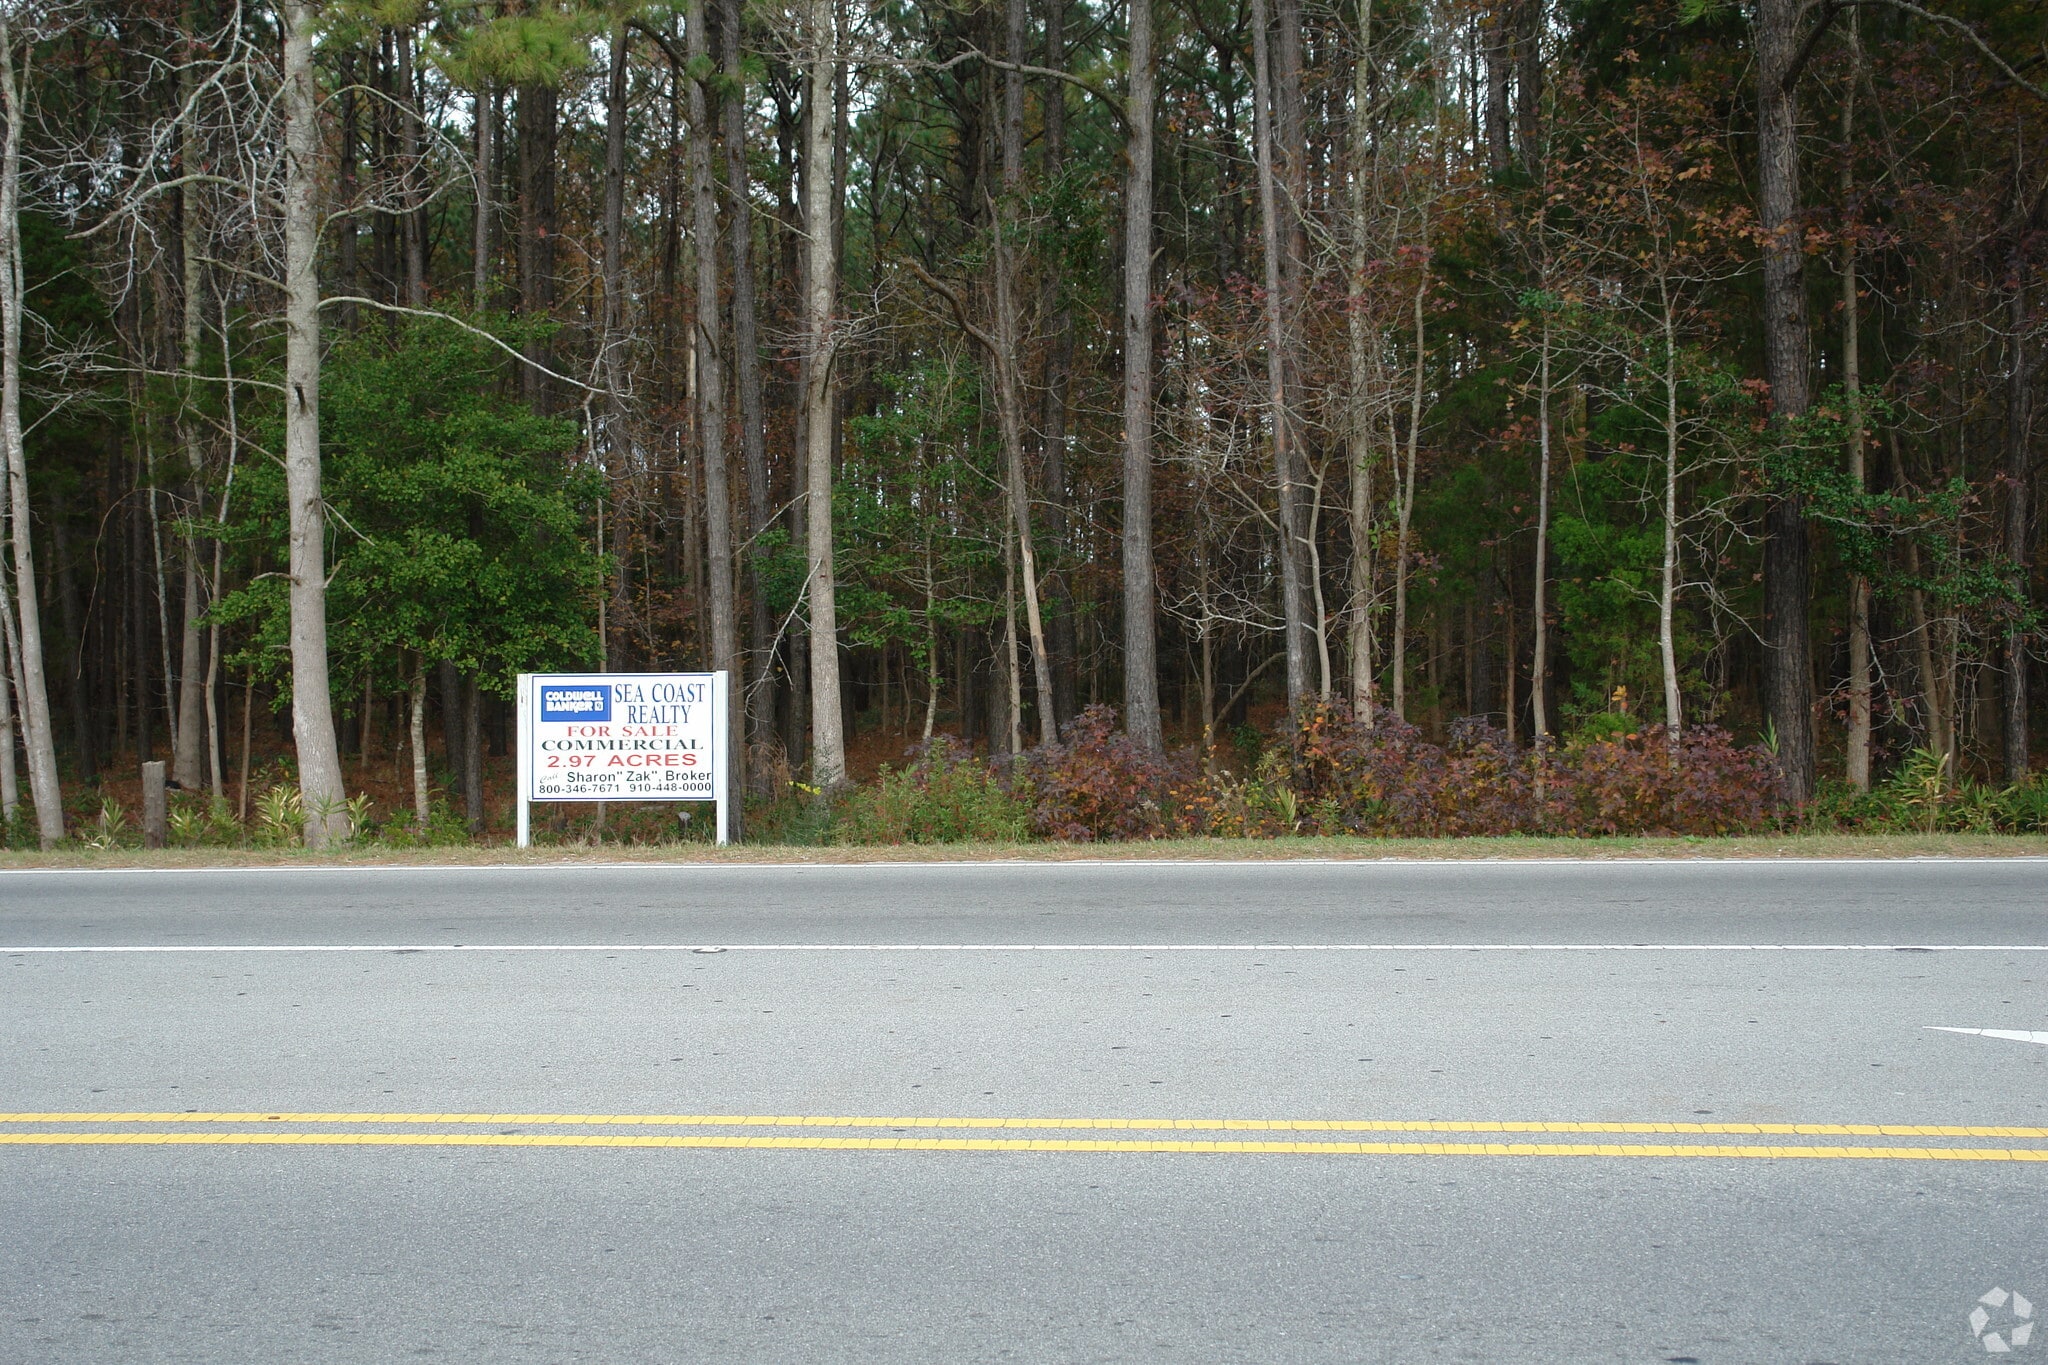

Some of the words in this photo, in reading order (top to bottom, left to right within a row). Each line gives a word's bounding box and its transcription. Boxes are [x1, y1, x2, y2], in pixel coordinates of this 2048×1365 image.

[615, 683, 644, 703] SEA
[652, 683, 705, 703] COAST
[627, 705, 691, 724] REALTY
[567, 725, 610, 737] FOR
[622, 725, 678, 737] SALE
[541, 739, 704, 751] COMMERCIAL
[547, 755, 596, 768] 2.97
[607, 753, 697, 767] ACRES
[665, 769, 712, 781] Broker
[539, 784, 620, 793] 800-346-7671
[629, 782, 712, 792] 910-448-0000
